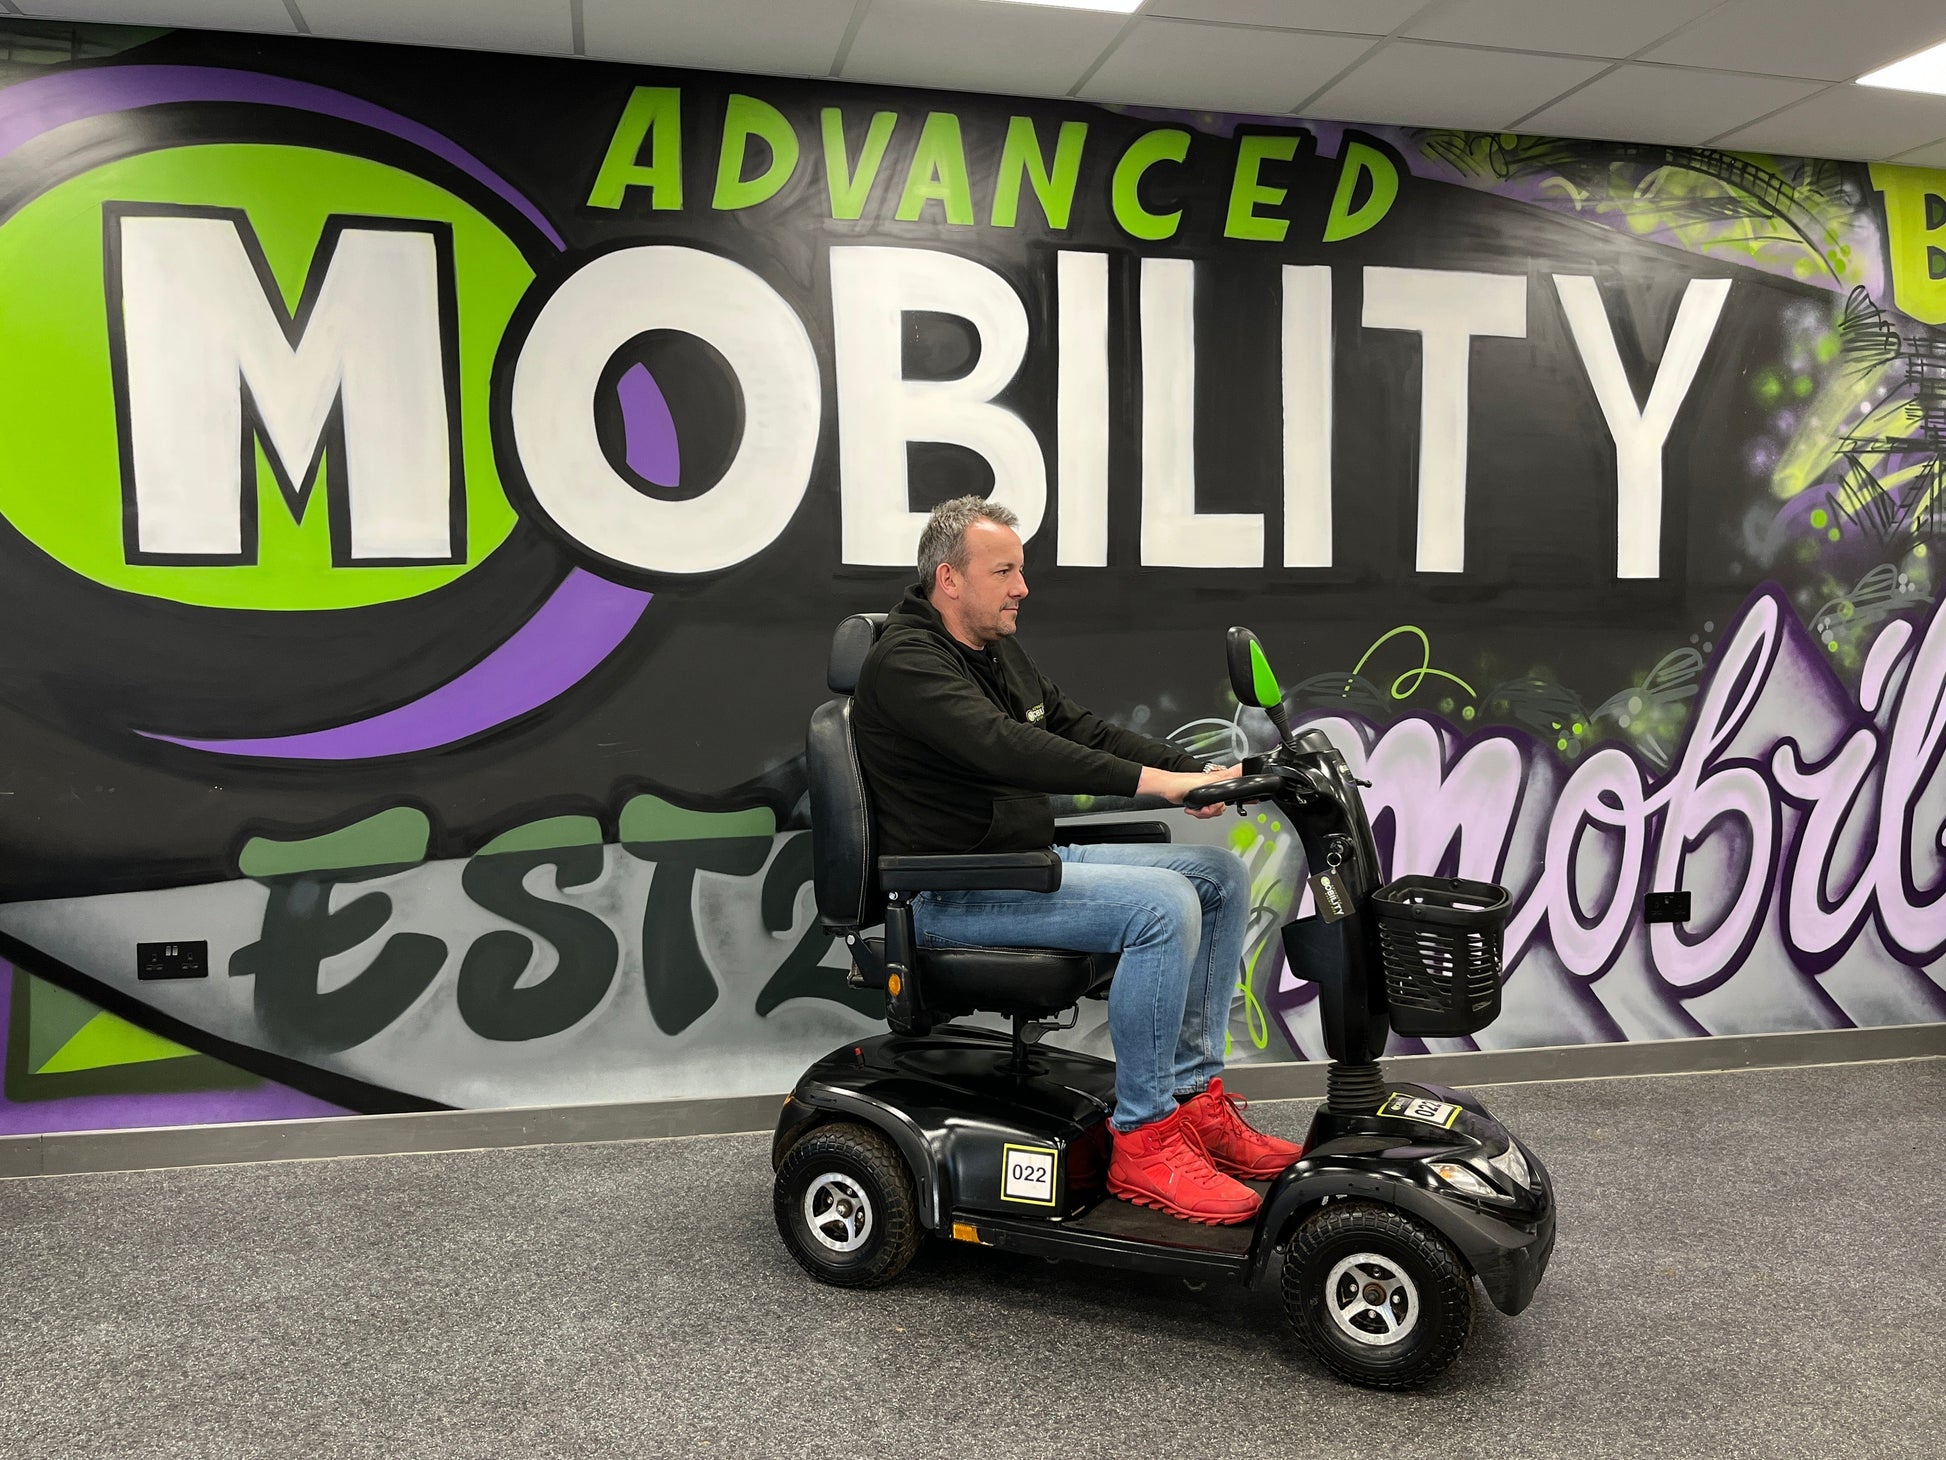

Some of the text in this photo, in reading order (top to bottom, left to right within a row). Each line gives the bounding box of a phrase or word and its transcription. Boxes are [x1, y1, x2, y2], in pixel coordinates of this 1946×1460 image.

[586, 86, 1399, 243] ADVANCED
[119, 216, 1732, 579] MOBILITY
[1012, 1164, 1046, 1183] 022
